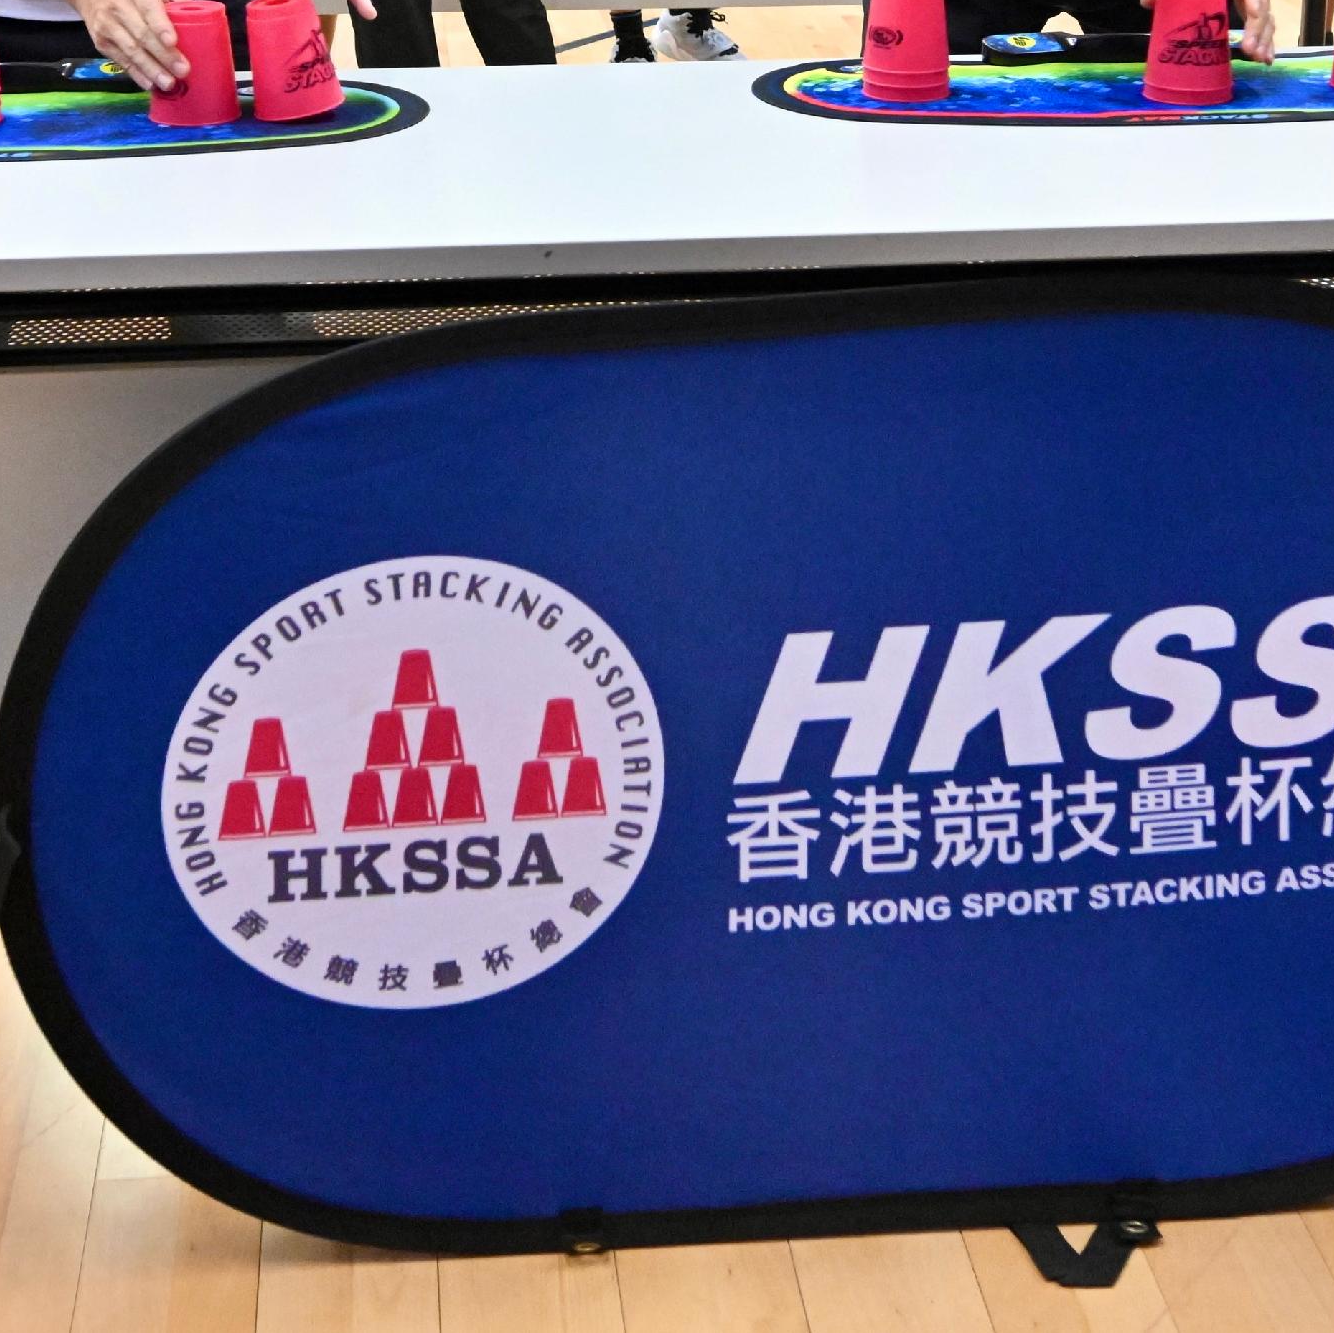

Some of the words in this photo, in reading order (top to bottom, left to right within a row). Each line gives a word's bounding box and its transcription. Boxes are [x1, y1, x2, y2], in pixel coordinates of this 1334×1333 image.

[233, 588, 346, 677] SPORT
[364, 570, 564, 631] STACKING
[177, 682, 239, 784] KONG
[565, 626, 653, 870] ASSOCIATION
[173, 801, 228, 897] HONG
[267, 832, 564, 903] HKSSA
[232, 886, 603, 992] 香港競技疊杯總會
[728, 901, 836, 933] HONG
[846, 895, 951, 926] KONG
[961, 886, 1079, 919] SPORT
[1088, 870, 1266, 910] STACKING
